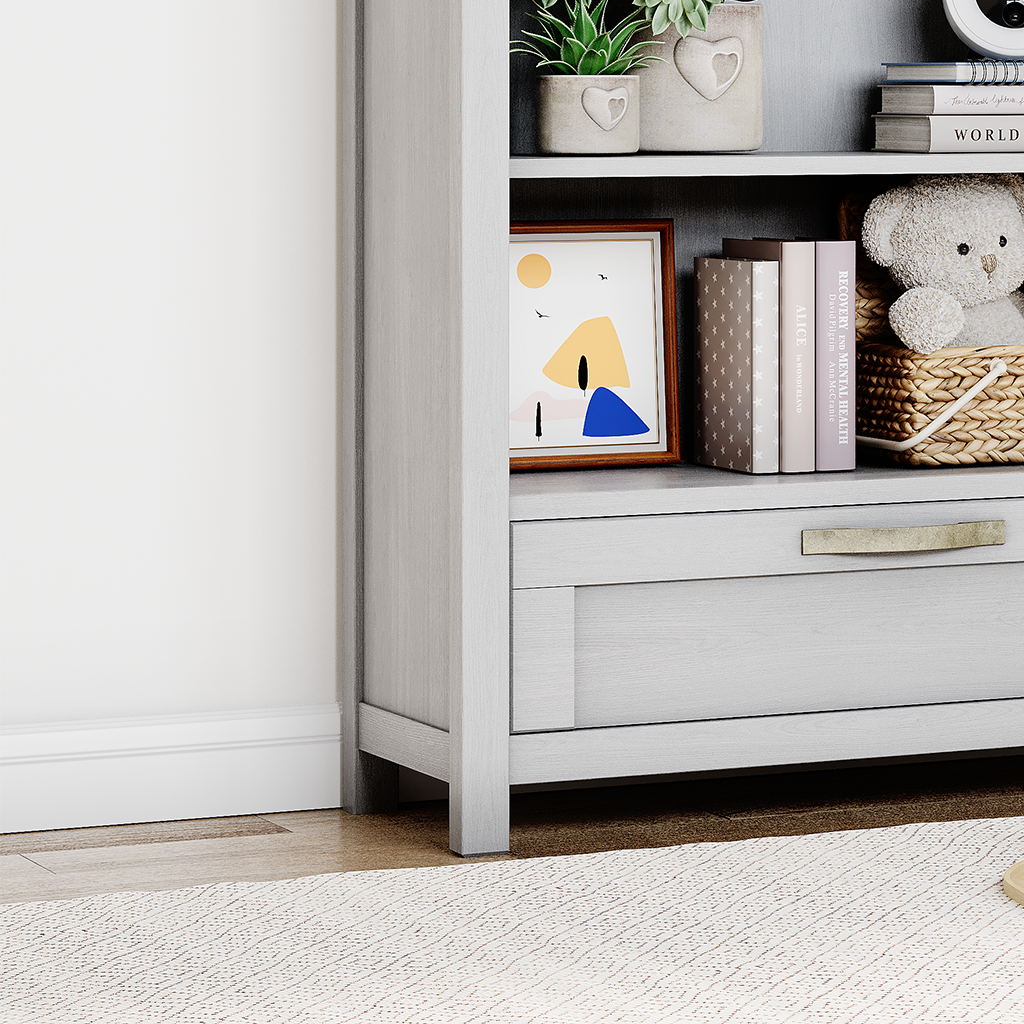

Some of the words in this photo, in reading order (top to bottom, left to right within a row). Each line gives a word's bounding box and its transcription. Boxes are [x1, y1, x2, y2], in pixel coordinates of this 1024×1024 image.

[954, 128, 1020, 142] WORLD
[829, 293, 837, 319] David
[838, 270, 849, 330] RECOVERY
[796, 304, 807, 347] ALICE
[827, 320, 837, 352] Pilgrim
[838, 334, 846, 350] END
[829, 361, 837, 379] Ann
[838, 352, 849, 398] MENTAL
[829, 380, 837, 423] McCranie
[838, 400, 849, 444] HEALTH
